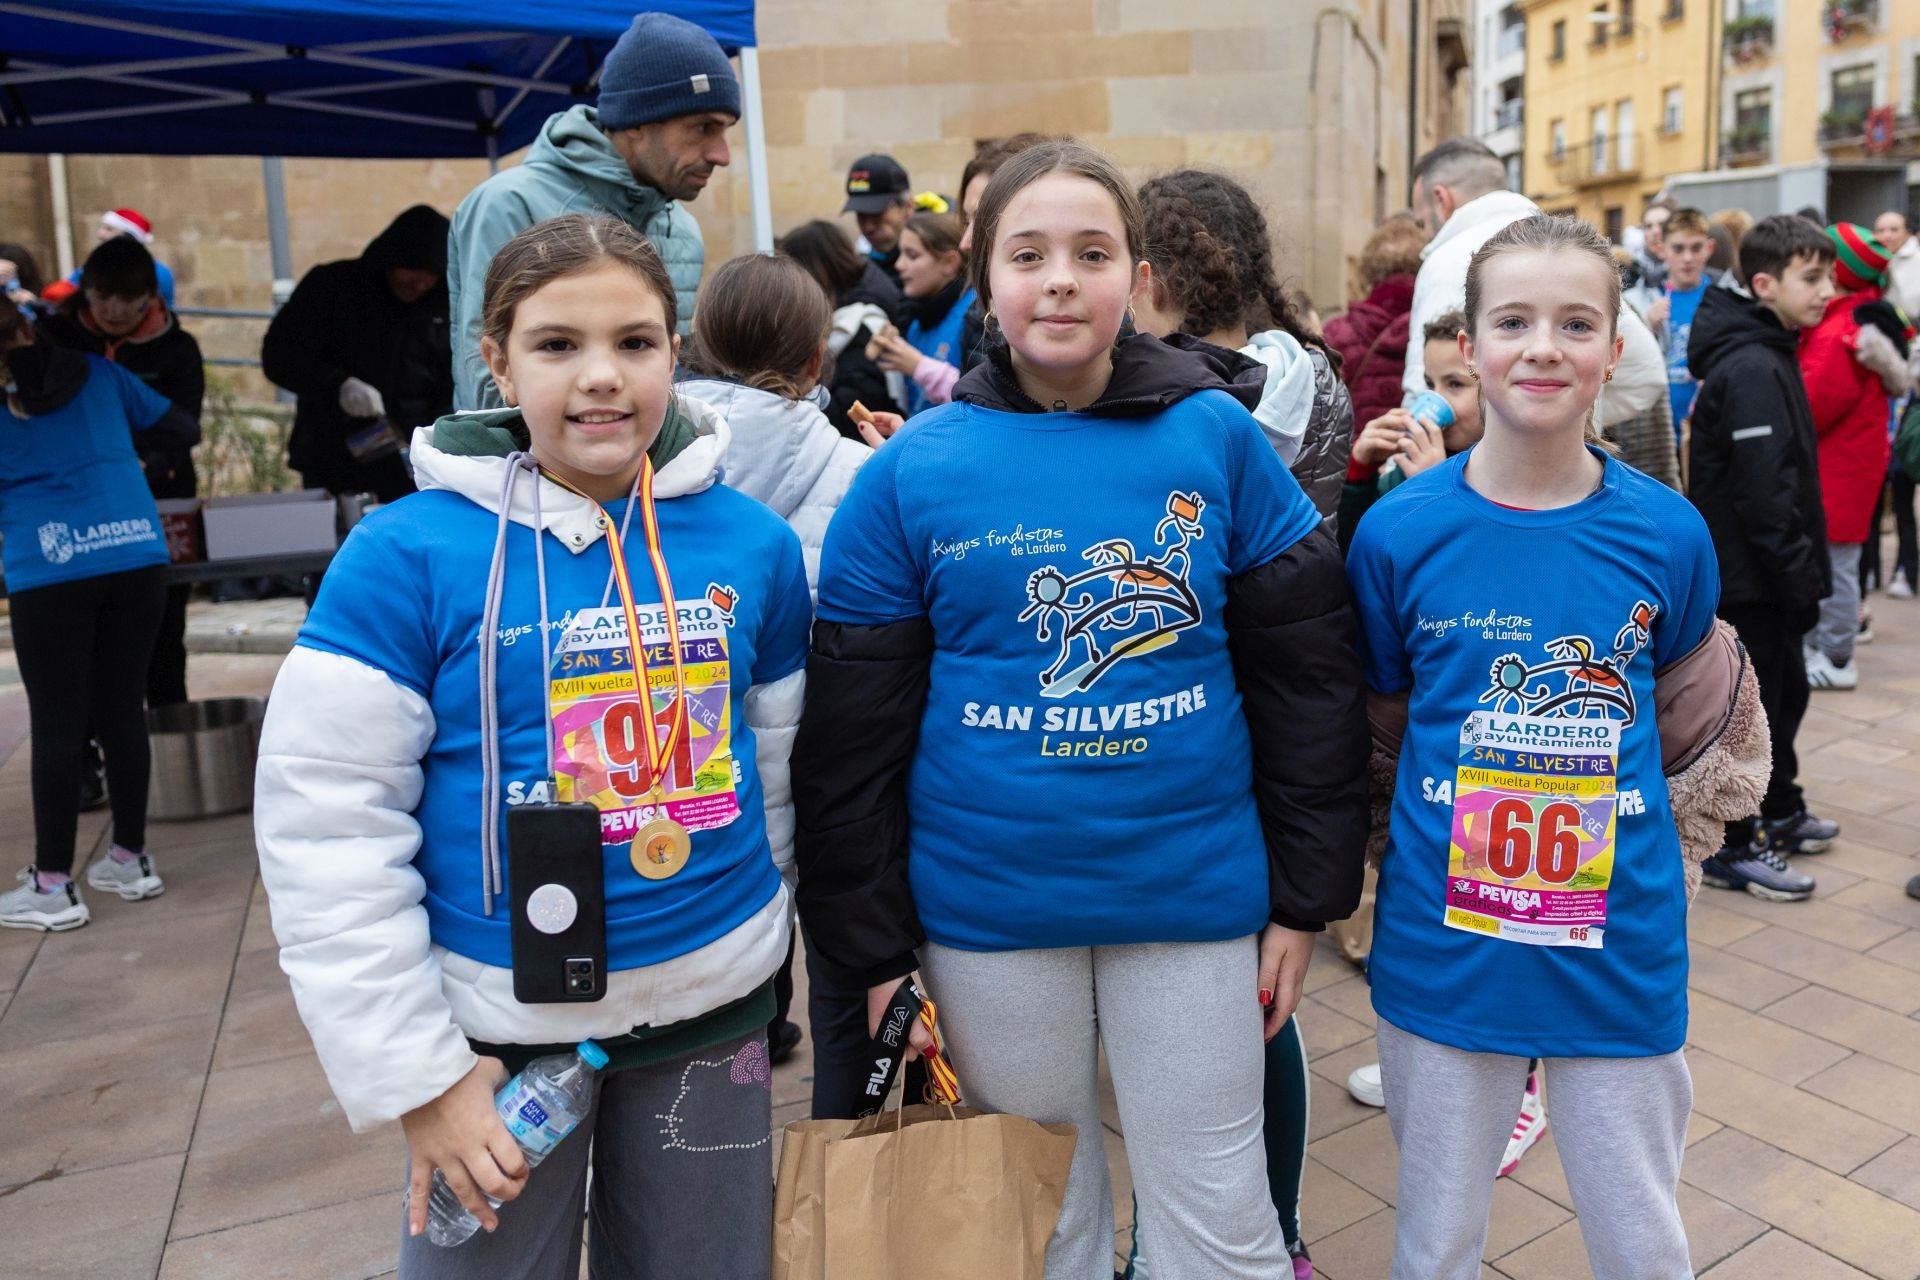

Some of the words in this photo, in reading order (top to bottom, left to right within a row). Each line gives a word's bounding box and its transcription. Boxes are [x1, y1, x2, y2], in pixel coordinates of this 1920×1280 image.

[73, 518, 152, 543] LARDERO
[931, 537, 981, 561] Amigos
[984, 523, 1064, 547] fondistas
[1011, 544, 1024, 557] de
[1026, 541, 1067, 555] Lardero
[476, 623, 533, 647] igos
[571, 622, 719, 644] ayuntmento
[1417, 613, 1458, 638] Amigos
[1461, 608, 1533, 629] fondistas
[1482, 630, 1495, 640] de
[1496, 630, 1532, 642] Lardero
[562, 651, 600, 671] SAN
[611, 641, 719, 666] SIVESTRE
[552, 680, 585, 697] XVIII
[589, 676, 633, 691] vuelta
[646, 670, 689, 689] opulr
[693, 666, 727, 680] 2024
[961, 701, 1034, 731] SAN
[1041, 683, 1207, 732] SILVESTRE
[1484, 731, 1612, 748] ayuntamiento
[1489, 718, 1609, 739] LARDERO
[600, 693, 697, 800] 91
[1040, 735, 1148, 757] Lardero
[1473, 747, 1505, 765] SAN
[1515, 753, 1609, 773] SILVESTRE
[1460, 768, 1489, 783] XVIII
[1493, 775, 1531, 788] vuelta
[1534, 778, 1580, 792] Popular
[1584, 779, 1614, 792] 2024
[505, 780, 559, 808] SA
[1485, 797, 1582, 884] 66
[1478, 883, 1542, 912] PEVISA
[1569, 927, 1589, 941] 66
[882, 1006, 910, 1047] FILA
[865, 1057, 892, 1096] FILA
